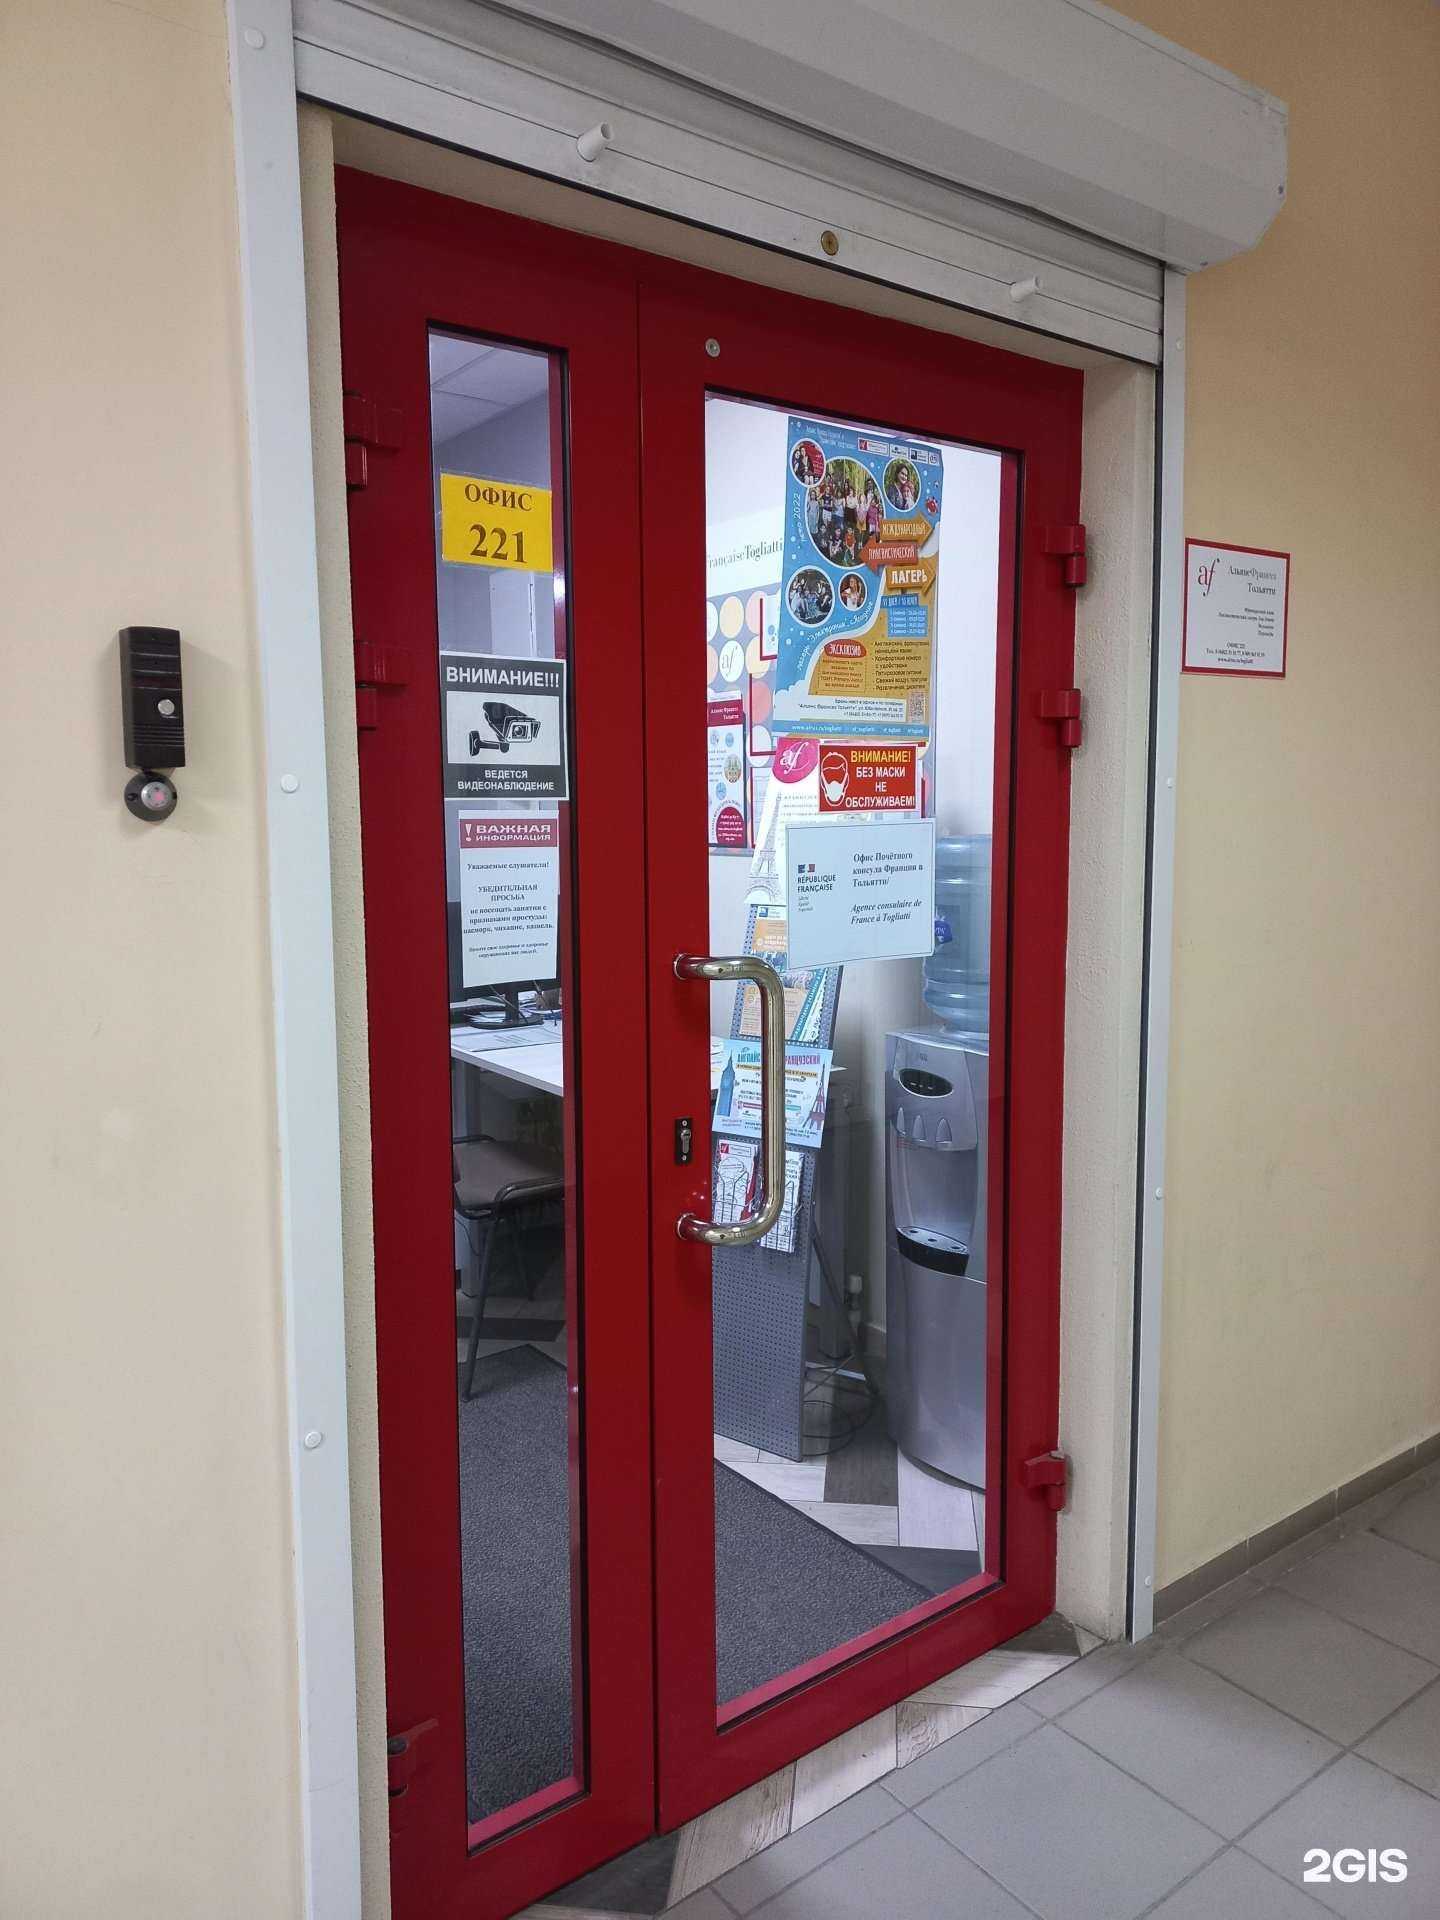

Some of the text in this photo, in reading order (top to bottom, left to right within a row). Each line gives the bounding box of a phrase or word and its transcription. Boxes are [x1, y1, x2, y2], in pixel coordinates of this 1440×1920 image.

[464, 483, 532, 511] ОФИС
[470, 524, 527, 563] 221
[891, 569, 928, 585] ЛАГЕРЬ
[446, 666, 560, 688] ВНИМАНИЕ!!!
[850, 750, 911, 763] ВНИМАНИЕ!
[484, 769, 528, 780] ВЕДЕТСЯ
[856, 766, 905, 778] БЕЗ МАСКИ
[457, 780, 554, 792] ВИДЕОНАБЛЮДЕНИЕ
[875, 781, 887, 792] НЕ
[845, 795, 915, 808] ОБСЛУЖИВАЕМ!
[476, 824, 551, 833] ВАЖНАЯ
[853, 852, 913, 864] Офис Почётного
[467, 863, 508, 871] Уважаемые
[852, 866, 882, 876] консула
[884, 864, 917, 875] Франции
[797, 874, 836, 884] RÉPUBLIQUE
[478, 884, 538, 893] УБЕДИТЕЛЬНАЯ
[797, 884, 833, 893] FRANÇAISE
[491, 894, 525, 902] ПРОСЬБА
[851, 899, 922, 914] Agence consulaire de
[851, 915, 875, 924] France
[882, 911, 911, 922] Togliatti
